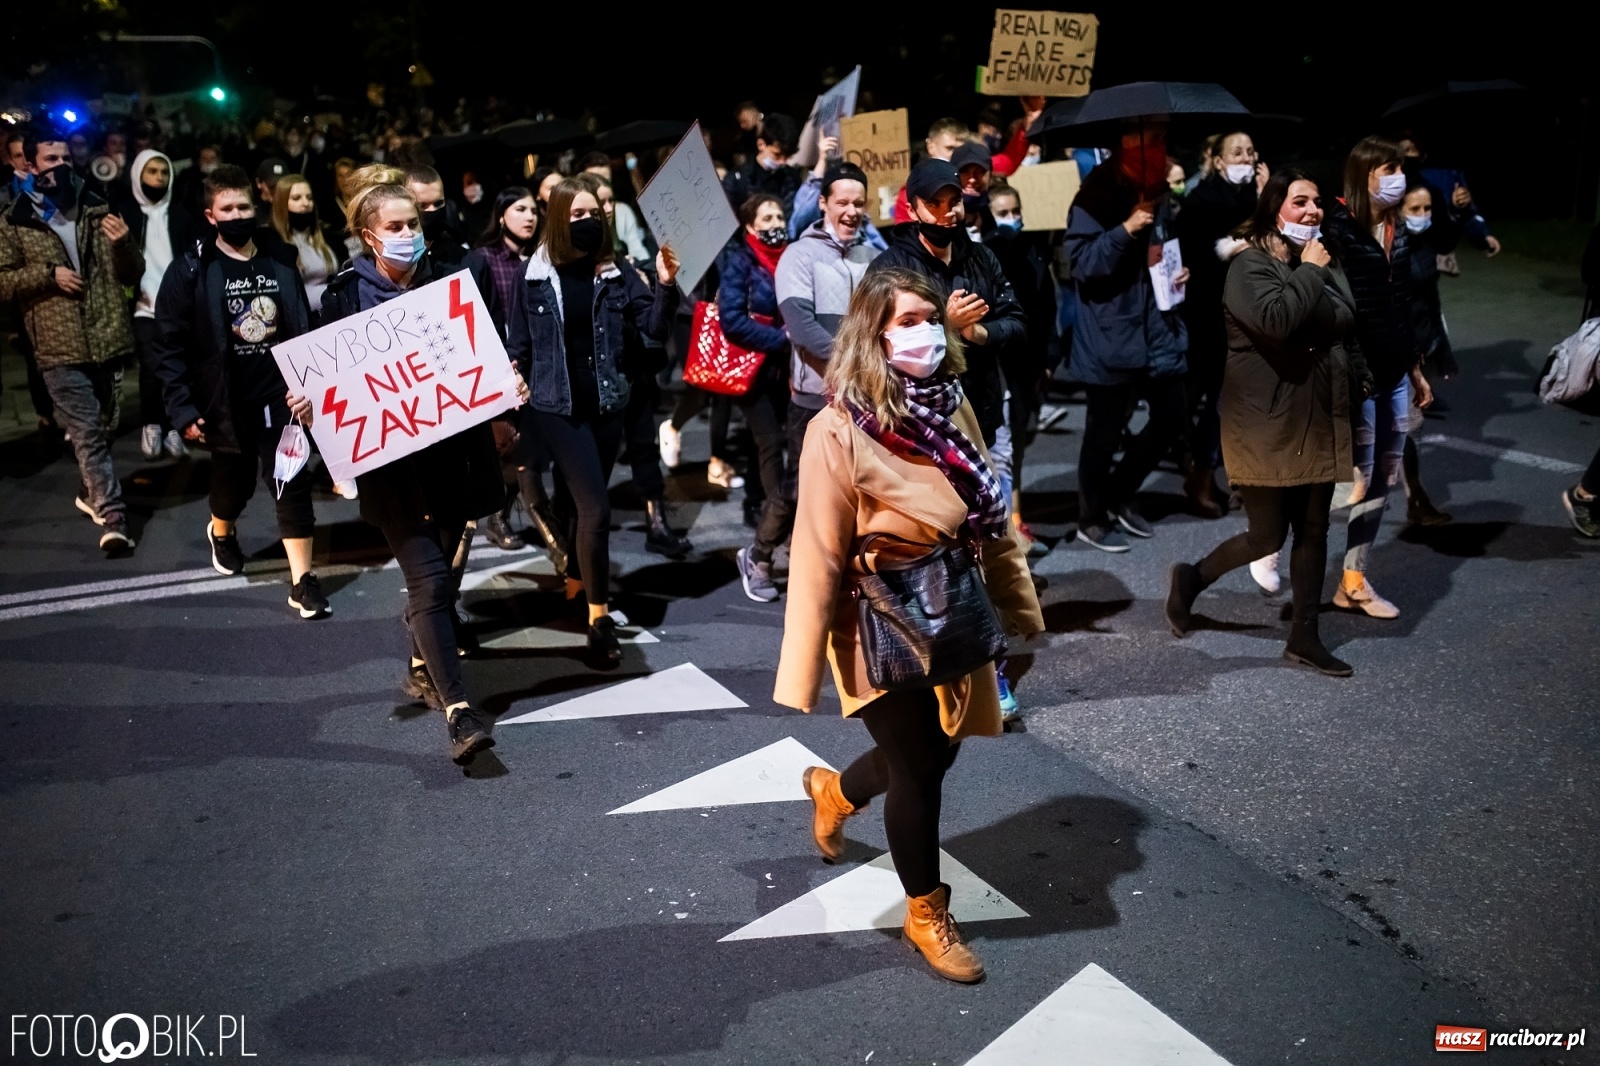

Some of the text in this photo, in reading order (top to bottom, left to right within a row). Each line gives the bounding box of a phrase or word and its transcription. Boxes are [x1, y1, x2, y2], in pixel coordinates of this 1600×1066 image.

[1000, 13, 1089, 41] REAL MEN
[992, 59, 1092, 86] FEMINISTS
[659, 184, 693, 247] KOBIET
[287, 307, 421, 388] WYBÓR
[364, 351, 435, 403] NIE
[340, 365, 504, 464] ZAKAZ
